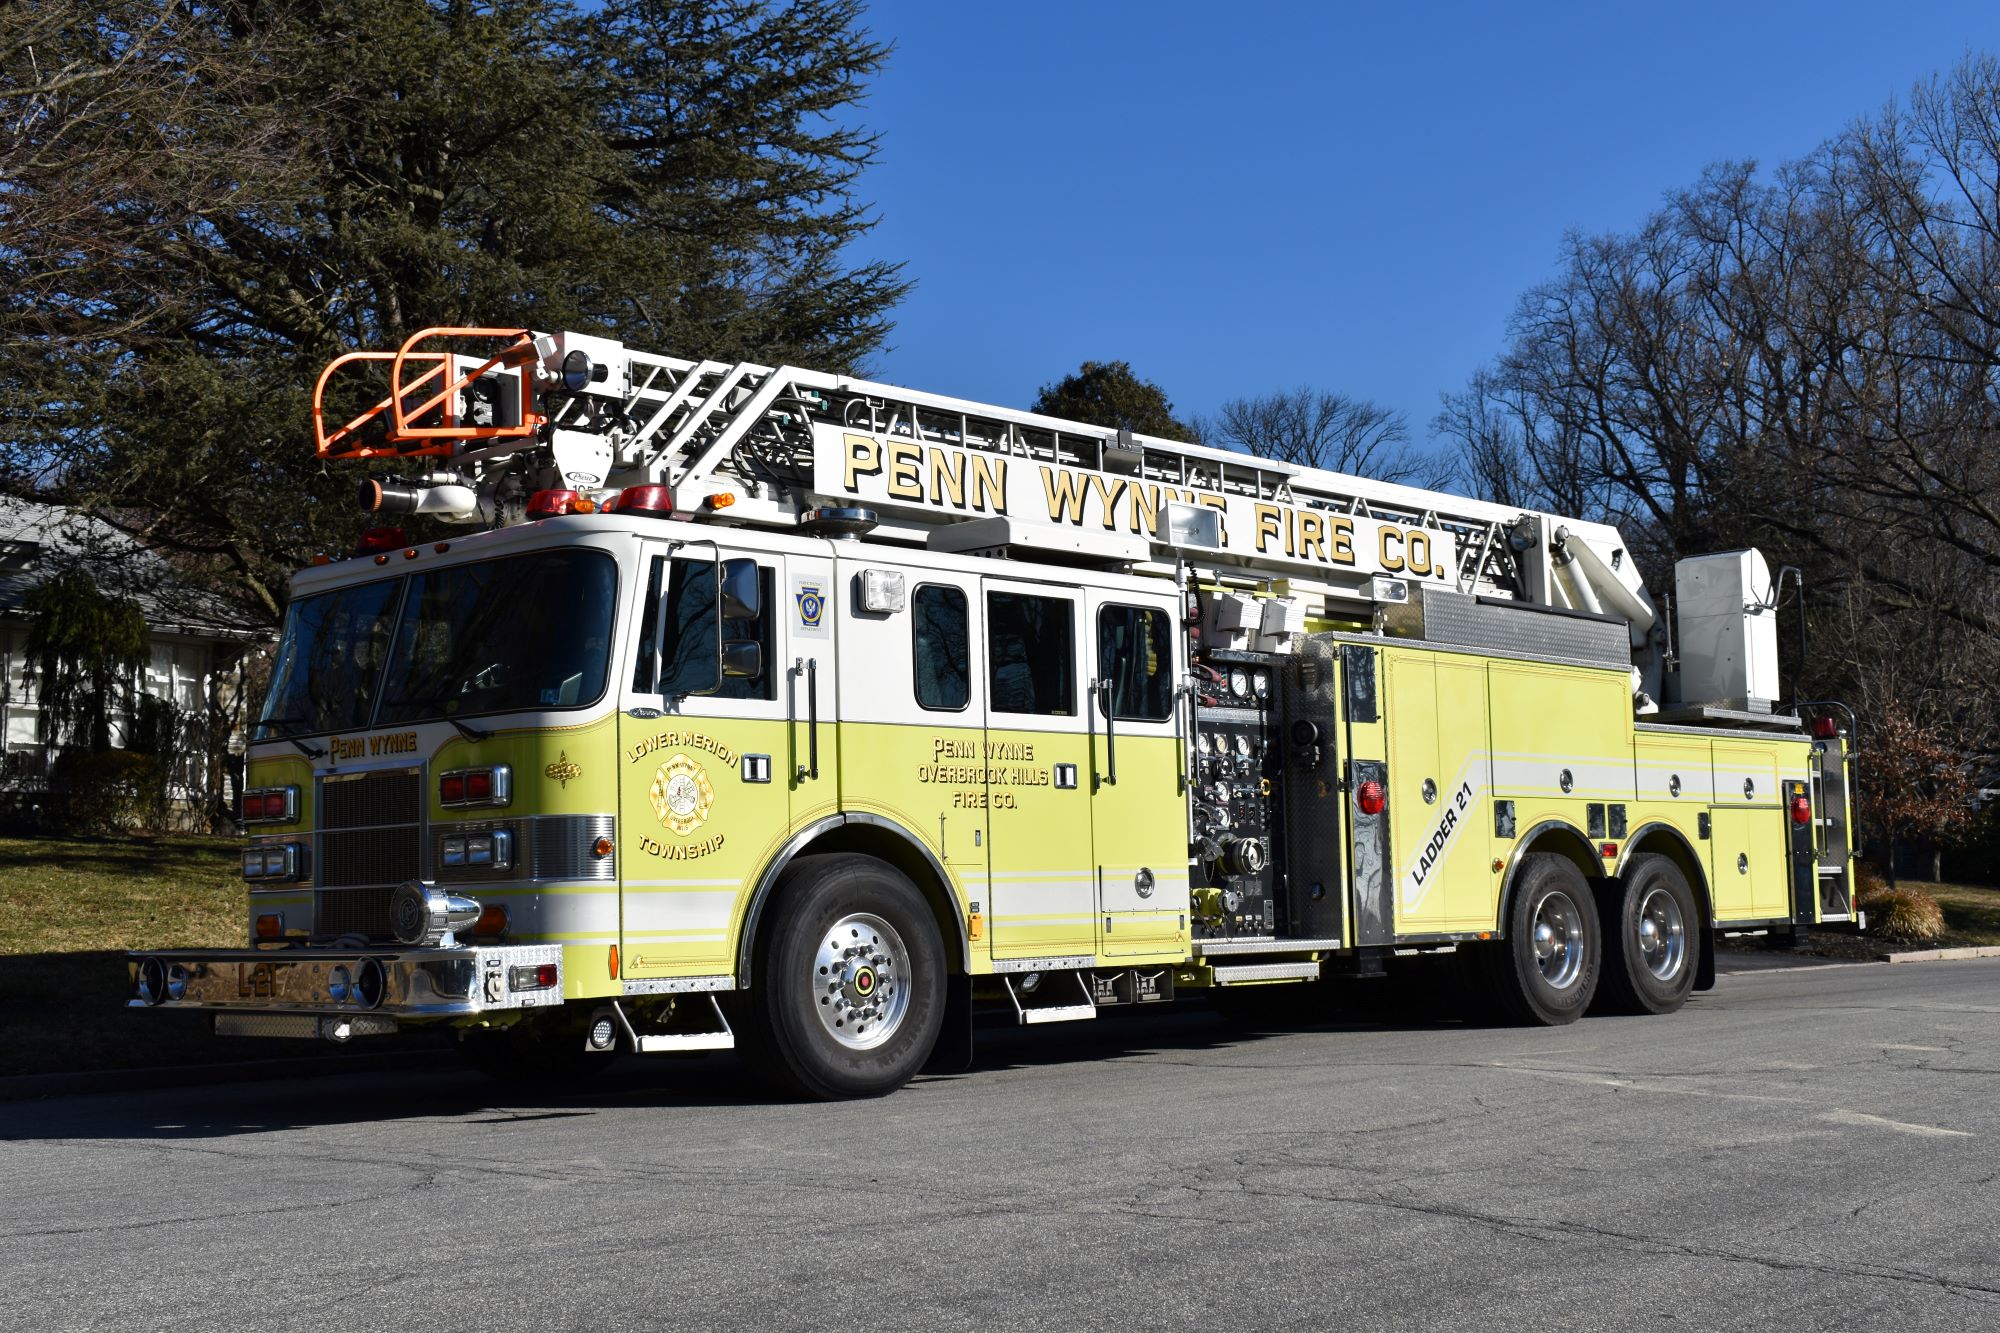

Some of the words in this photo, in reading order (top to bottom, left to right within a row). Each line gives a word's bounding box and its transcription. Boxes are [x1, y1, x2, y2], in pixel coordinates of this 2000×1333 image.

[843, 433, 1008, 516] PENN
[1254, 503, 1355, 566] FIRE
[1378, 525, 1444, 580] CO.
[329, 735, 365, 764] PENN
[369, 731, 417, 756] WYNNE
[625, 731, 680, 764] LOWER
[682, 731, 739, 768] MERION
[932, 736, 975, 763] PENN
[981, 742, 1034, 761] WYNNE
[918, 764, 1008, 785] OVERBROOK
[1011, 767, 1049, 786] HILLS
[952, 791, 988, 809] FIRE
[992, 792, 1018, 809] CO.
[639, 833, 725, 860] TOWNSHIP
[1412, 808, 1457, 886] LADDER
[1456, 781, 1472, 811] 21
[239, 962, 277, 997] L-21
